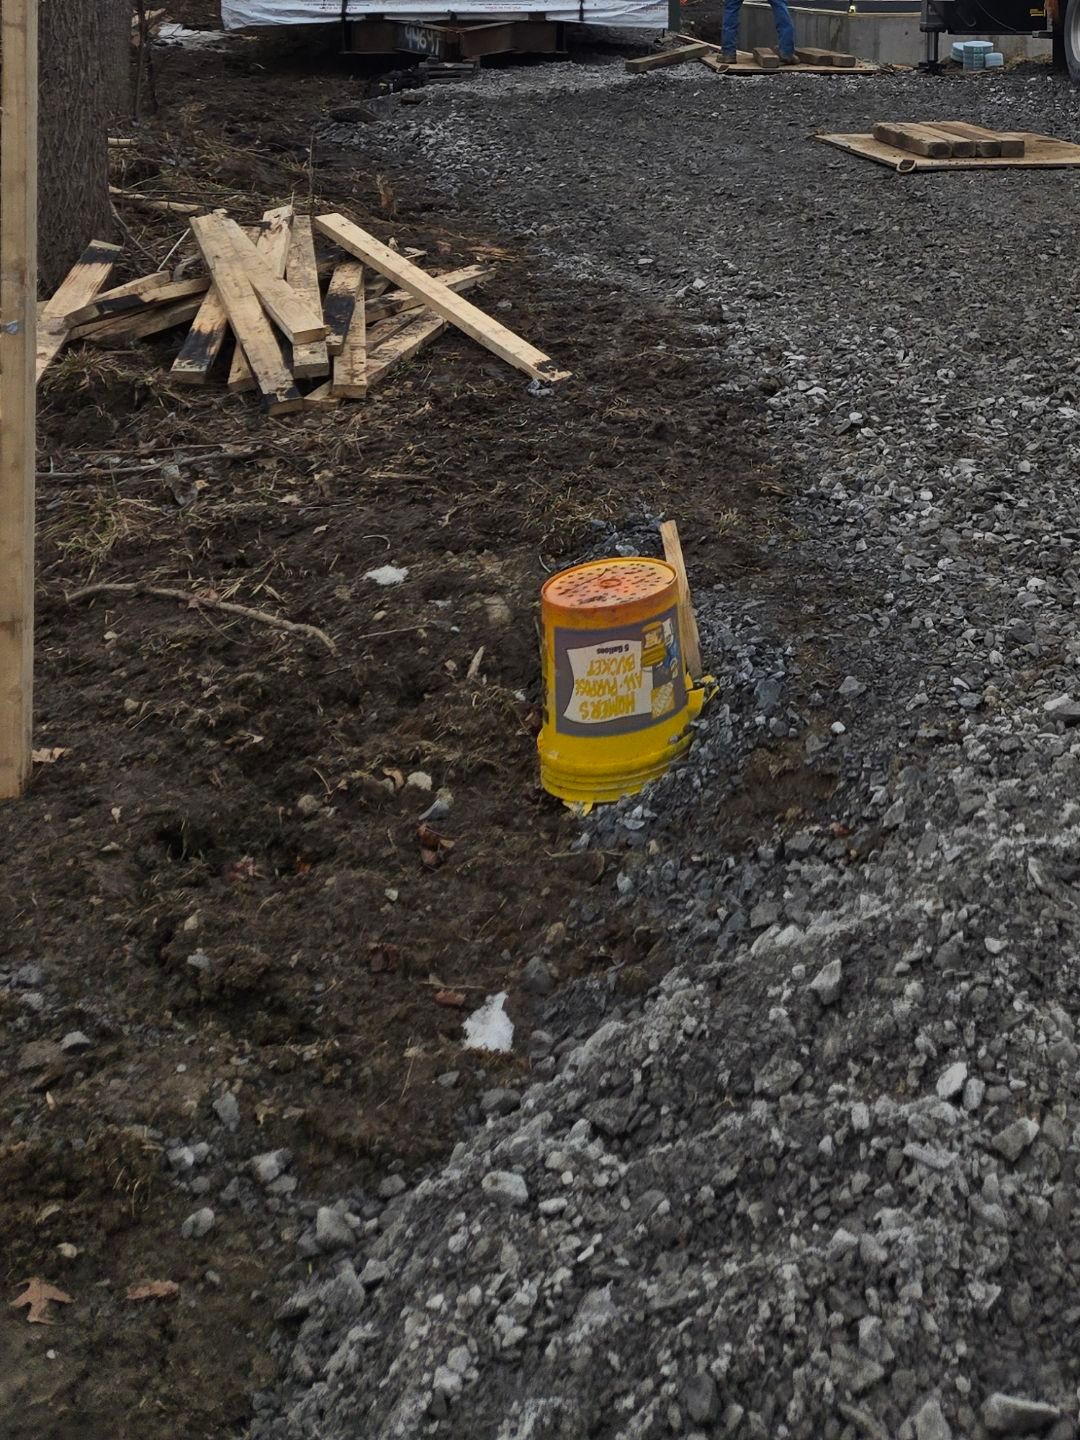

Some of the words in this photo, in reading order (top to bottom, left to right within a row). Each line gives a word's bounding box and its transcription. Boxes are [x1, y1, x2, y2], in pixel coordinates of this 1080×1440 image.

[596, 645, 623, 654] Gallons
[625, 644, 630, 652] 5
[587, 654, 635, 676] BUCKET
